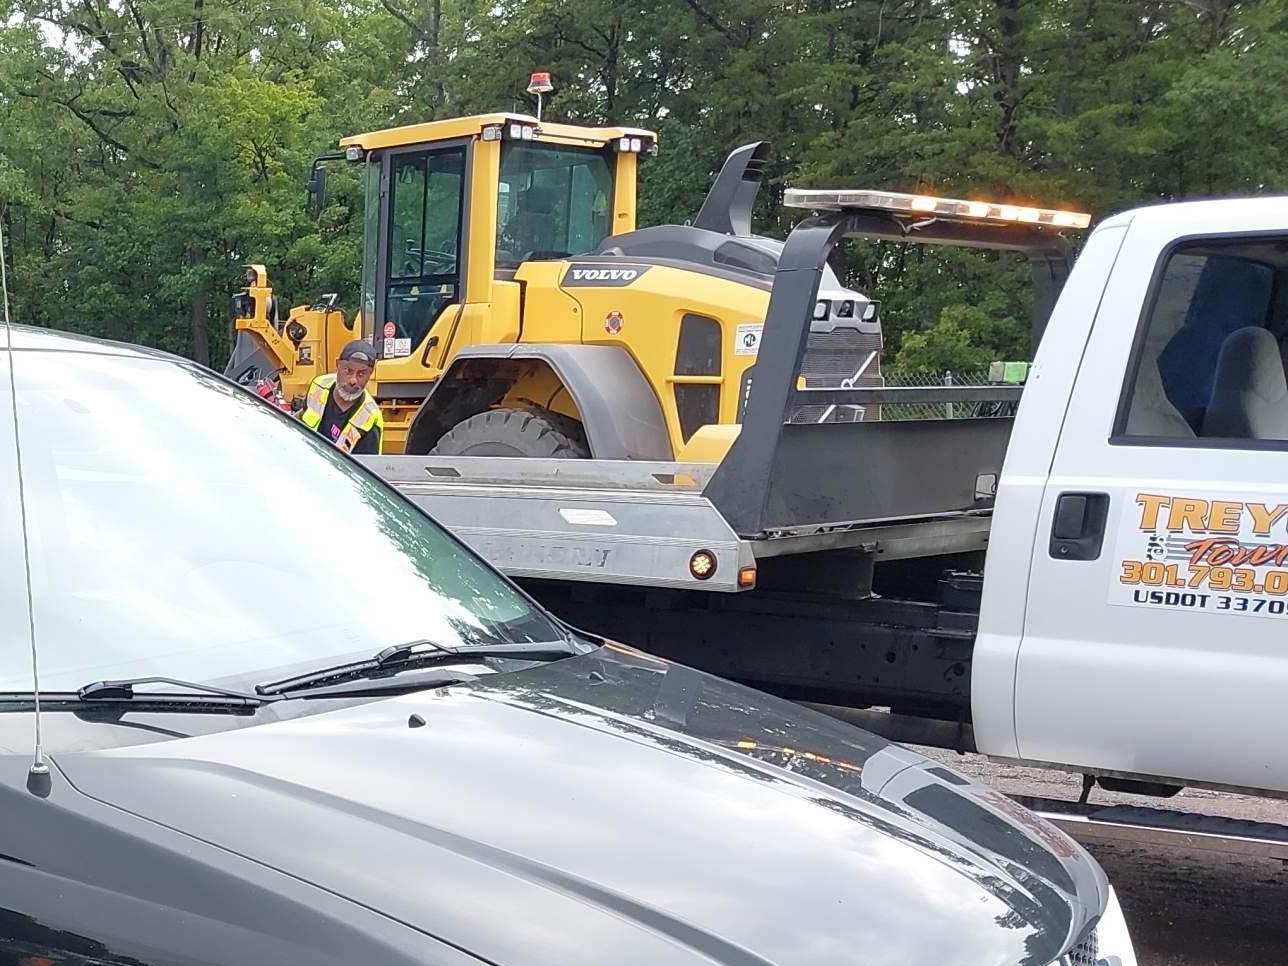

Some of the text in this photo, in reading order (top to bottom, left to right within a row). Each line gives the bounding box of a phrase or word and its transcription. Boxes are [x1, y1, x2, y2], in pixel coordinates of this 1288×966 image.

[572, 269, 638, 281] VOLVO
[1135, 493, 1288, 536] TREY
[1120, 561, 1288, 595] 301.793.0
[1133, 590, 1288, 615] USDOT 3370
